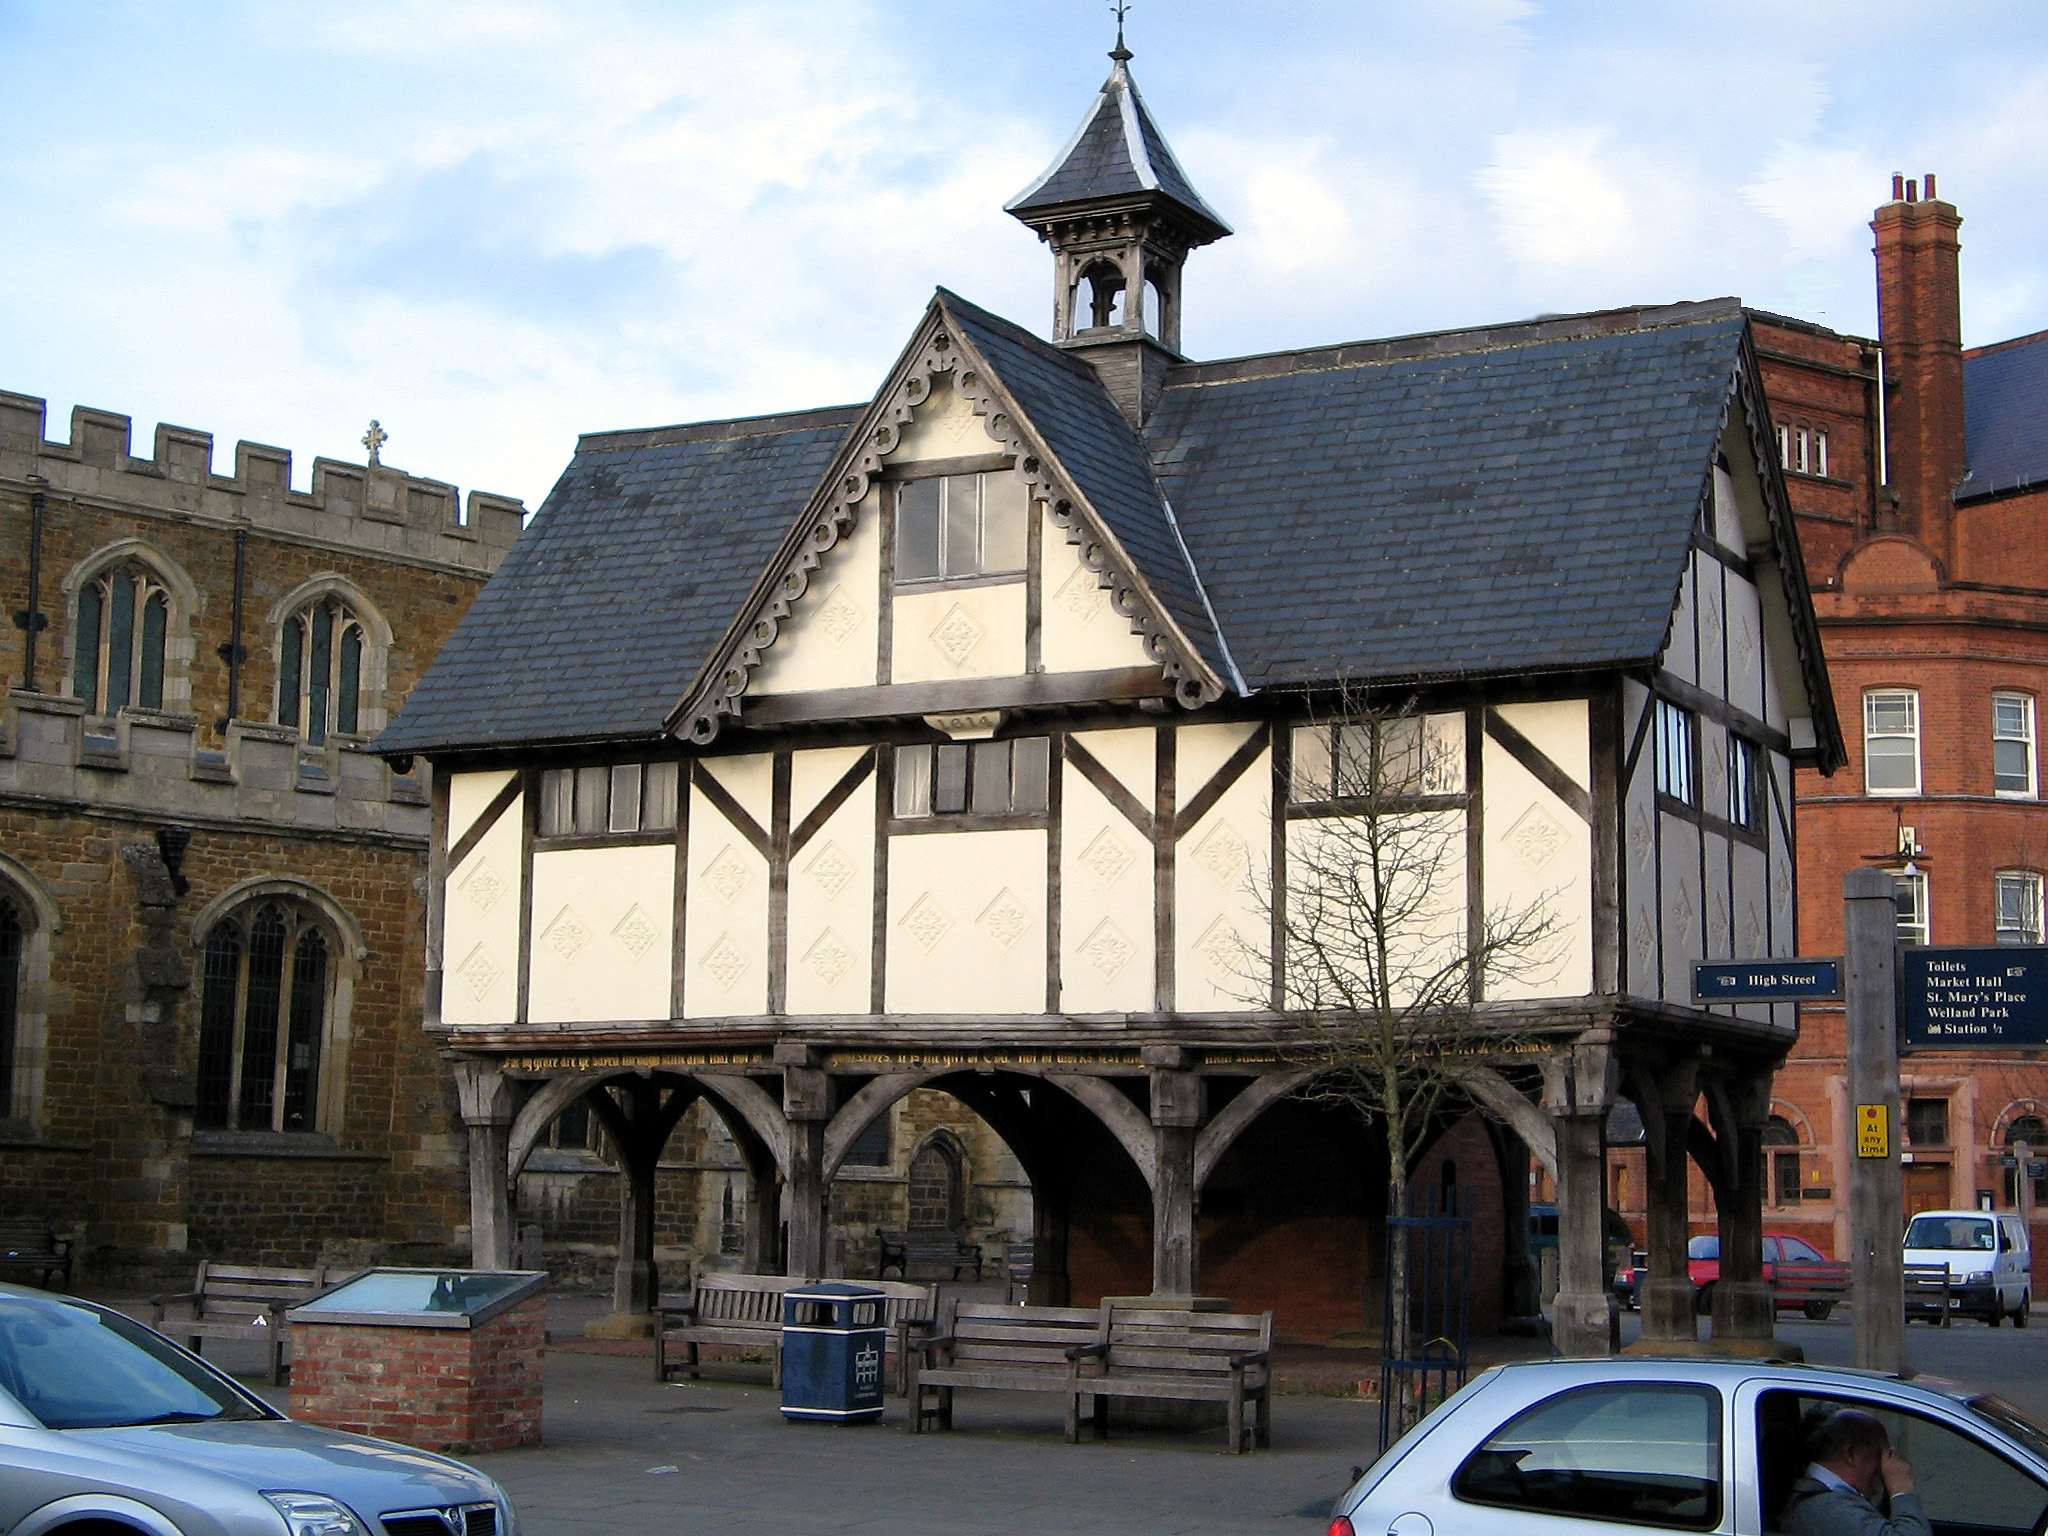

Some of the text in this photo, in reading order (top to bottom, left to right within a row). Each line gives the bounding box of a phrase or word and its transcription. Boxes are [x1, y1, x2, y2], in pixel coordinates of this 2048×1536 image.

[1926, 961, 1967, 972] Toilets
[1748, 975, 1816, 987] High Street
[1927, 976, 2002, 987] Market Hall
[1926, 991, 2026, 1004] St. Mary's Place
[1928, 1007, 2009, 1018] Welland Park
[1944, 1023, 1987, 1034] Station
[1866, 1124, 1878, 1132] At
[1864, 1136, 1882, 1144] any
[1861, 1145, 1886, 1154] time
